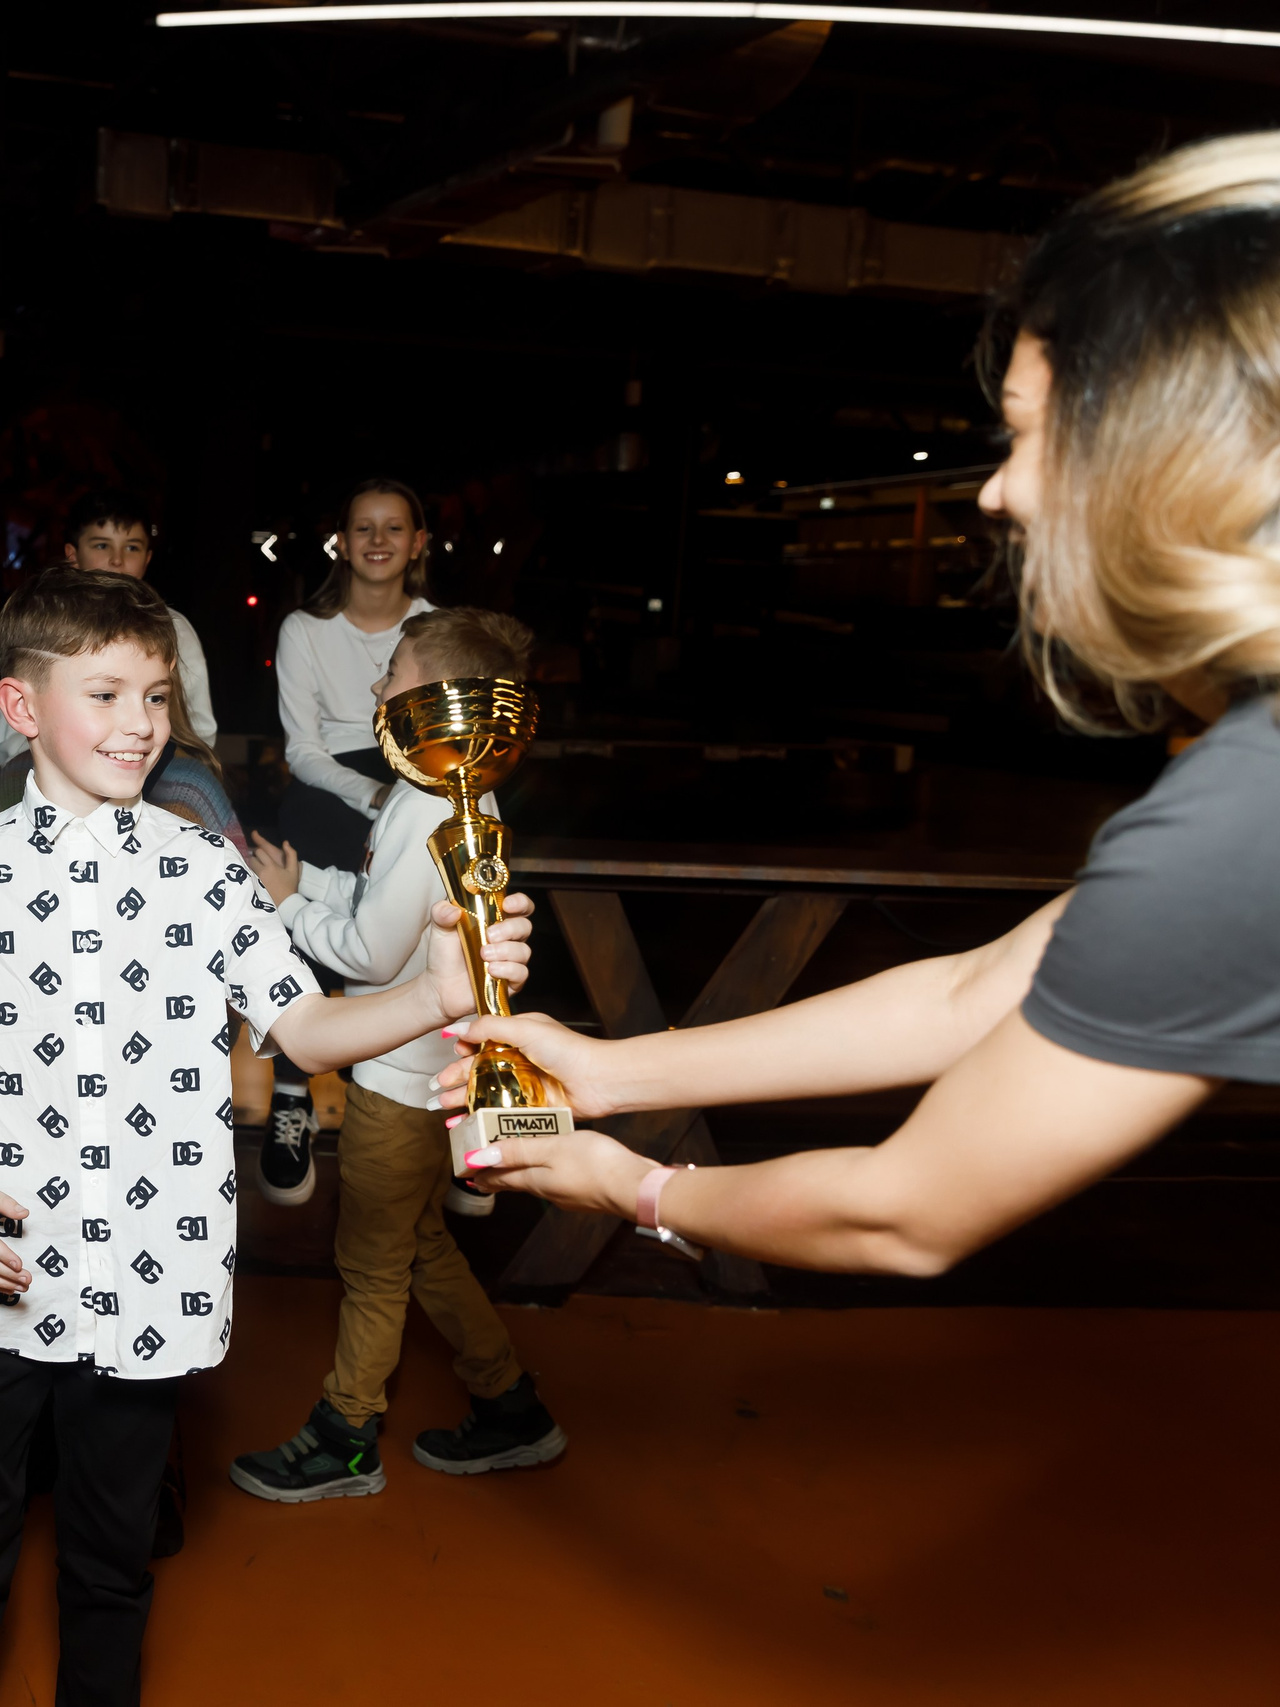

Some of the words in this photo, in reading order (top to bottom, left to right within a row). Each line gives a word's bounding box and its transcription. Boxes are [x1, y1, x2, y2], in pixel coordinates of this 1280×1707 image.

[160, 857, 189, 879] DG
[27, 890, 59, 922] DG
[116, 887, 147, 921] DG
[72, 930, 103, 954] DG
[164, 922, 194, 948] DG
[231, 924, 260, 958] DG
[28, 962, 62, 996] DG
[119, 959, 149, 993] DG
[269, 974, 304, 1007] DG
[165, 994, 196, 1020] DG
[32, 1032, 65, 1067] DG
[122, 1031, 153, 1065] DG
[77, 1073, 108, 1098] DG
[170, 1068, 201, 1093] DG
[36, 1105, 69, 1139] DG
[125, 1103, 157, 1137] DG
[502, 1118, 556, 1132] ТИМАТИ
[80, 1146, 111, 1171] DG
[173, 1141, 203, 1166] DG
[36, 1176, 70, 1210] DG
[126, 1176, 159, 1210] DG
[81, 1218, 112, 1243] DG
[177, 1215, 208, 1242] DG
[35, 1245, 69, 1278] DG
[130, 1250, 164, 1285] DG
[181, 1292, 214, 1317] DG
[33, 1313, 66, 1347] DG
[132, 1325, 167, 1361] DG
